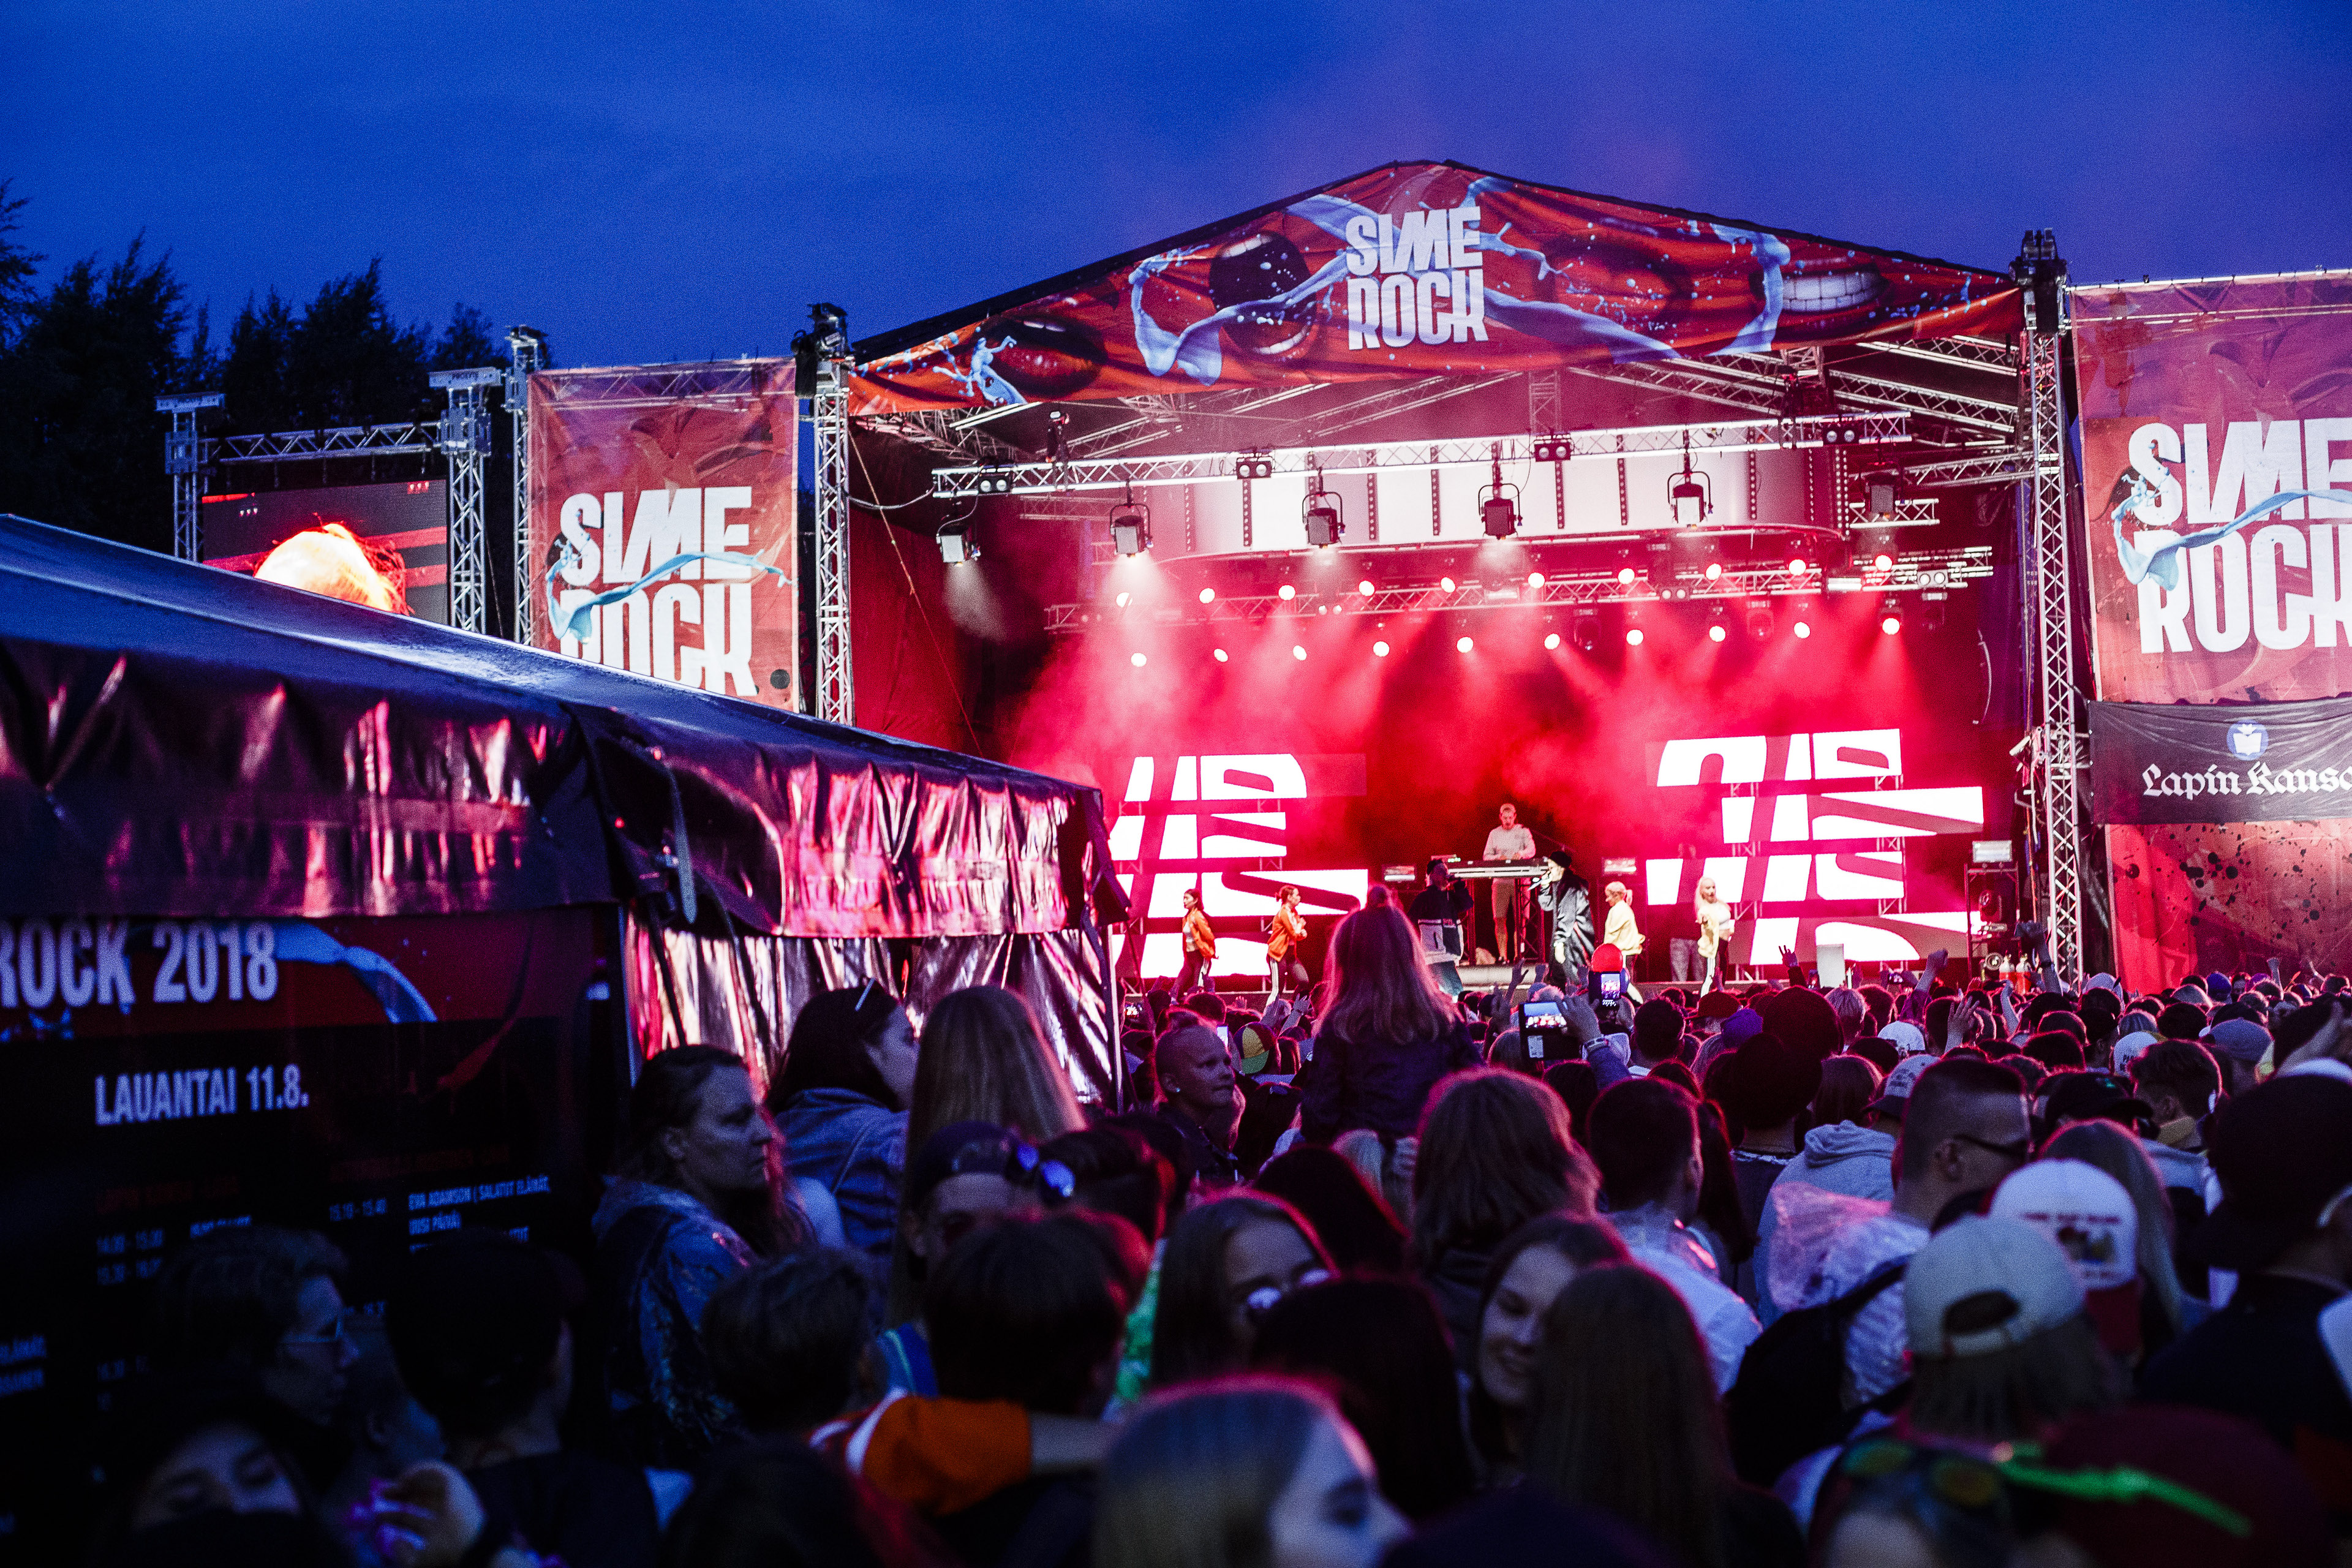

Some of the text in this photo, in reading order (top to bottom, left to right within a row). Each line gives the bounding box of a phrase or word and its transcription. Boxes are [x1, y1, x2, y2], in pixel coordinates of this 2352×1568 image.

[1346, 206, 1483, 276] SIME
[1348, 269, 1489, 350] ROCK
[2128, 417, 2352, 526] SIME
[560, 486, 752, 587] SIME
[2133, 523, 2352, 654] ROCK
[2143, 763, 2242, 801] Lapin
[152, 920, 279, 1003] 2018
[95, 1063, 309, 1126] LAUANTAI 11.8.
